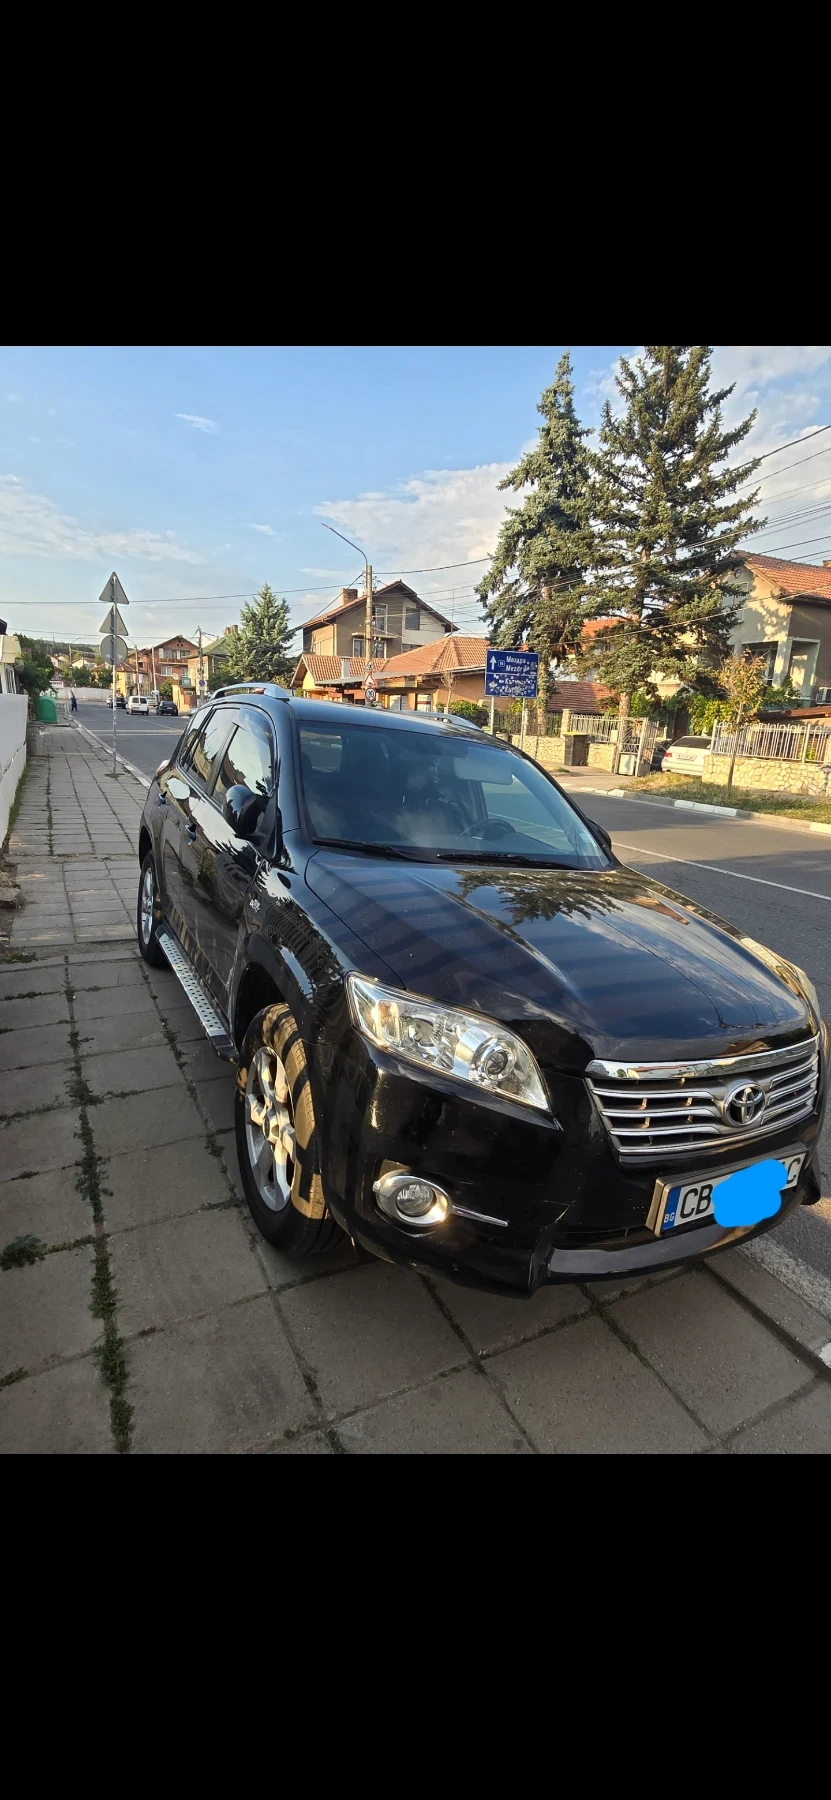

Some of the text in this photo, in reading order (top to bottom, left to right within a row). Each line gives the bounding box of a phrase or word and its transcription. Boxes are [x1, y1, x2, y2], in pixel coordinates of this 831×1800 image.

[506, 656, 526, 665] Мездра
[680, 1184, 713, 1218] CB
[663, 1212, 676, 1223] BG
